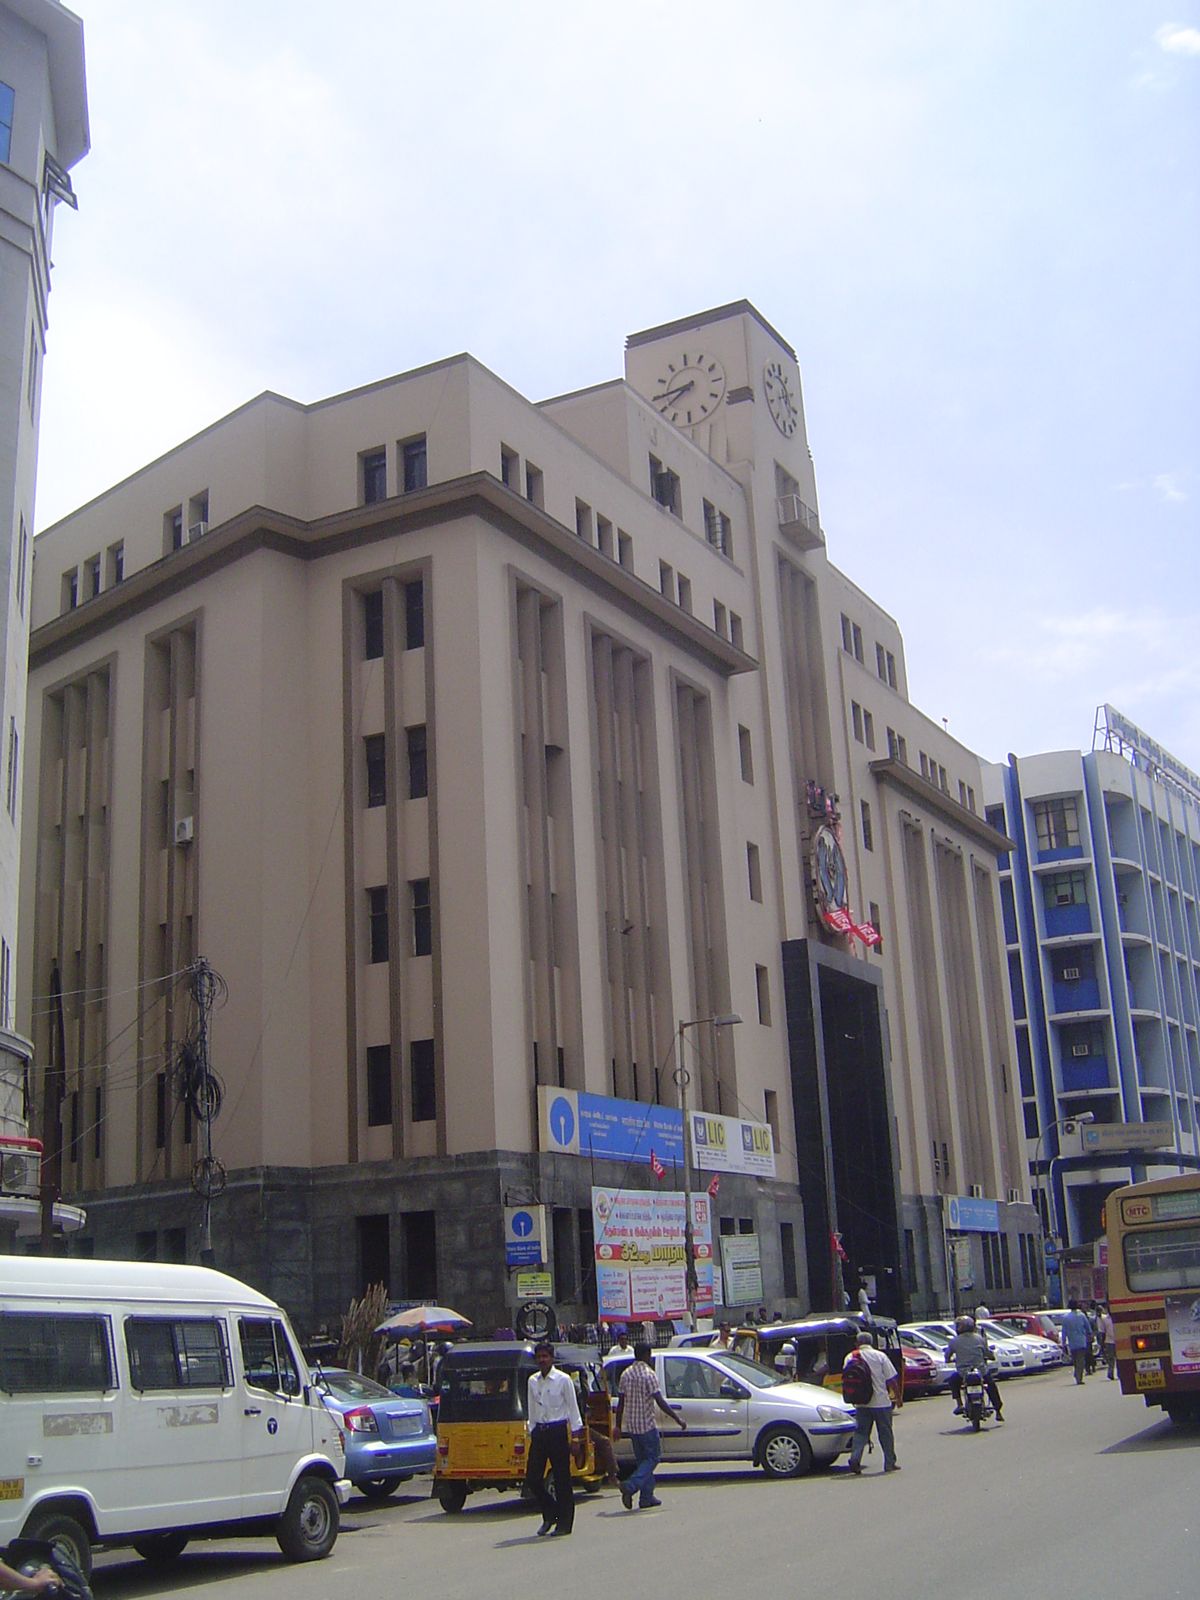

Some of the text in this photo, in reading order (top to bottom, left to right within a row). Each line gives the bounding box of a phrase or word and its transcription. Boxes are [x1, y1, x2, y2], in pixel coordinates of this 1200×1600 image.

[708, 1121, 724, 1145] LIC
[753, 1129, 769, 1151] LIC
[1129, 1207, 1148, 1216] MTC
